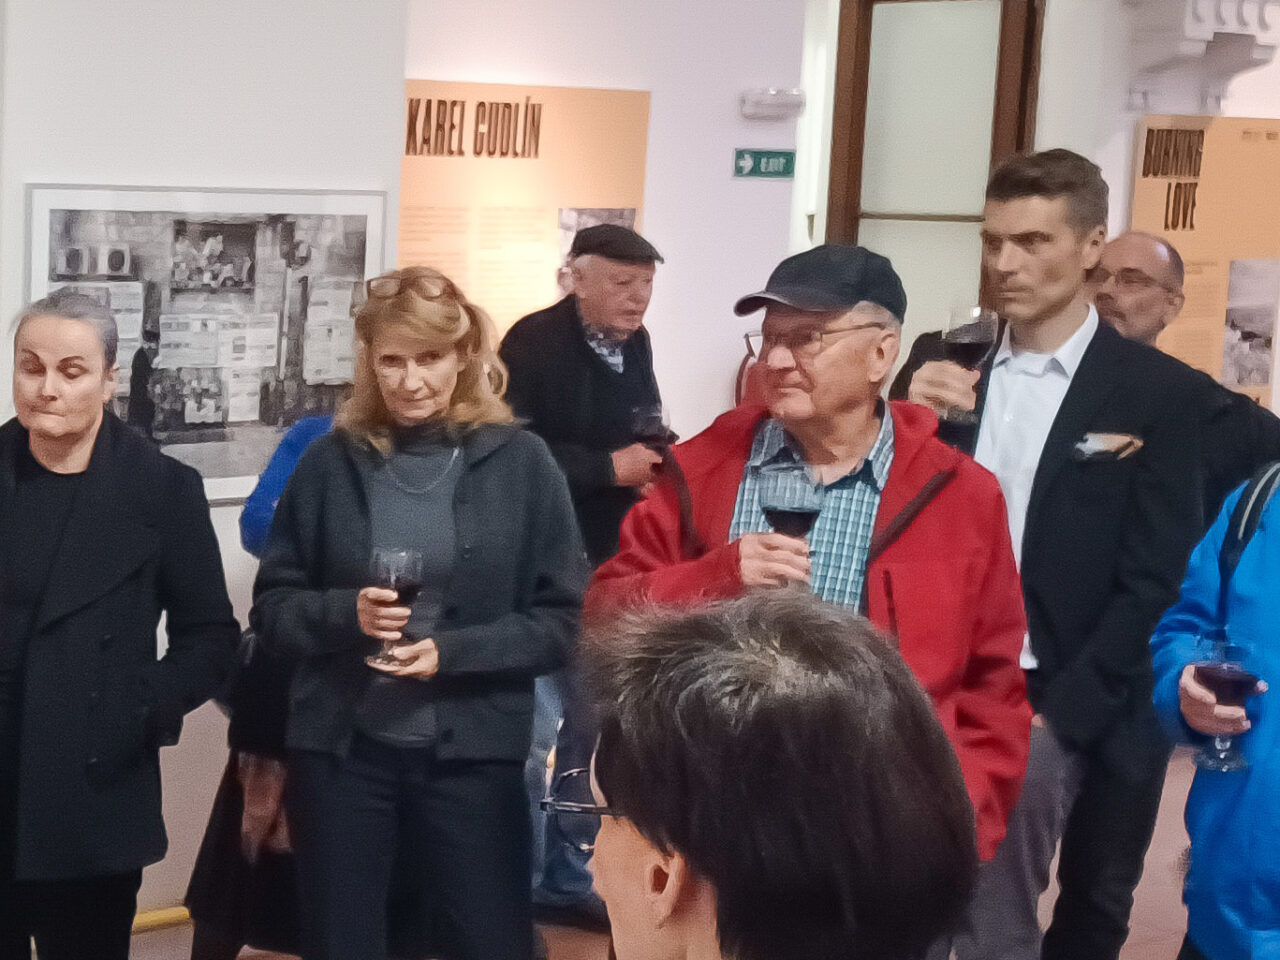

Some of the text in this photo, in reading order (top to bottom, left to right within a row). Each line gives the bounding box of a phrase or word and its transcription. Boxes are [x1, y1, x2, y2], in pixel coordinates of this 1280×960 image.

[405, 95, 543, 159] KAREL CUDLÍN
[759, 156, 787, 173] EXIT
